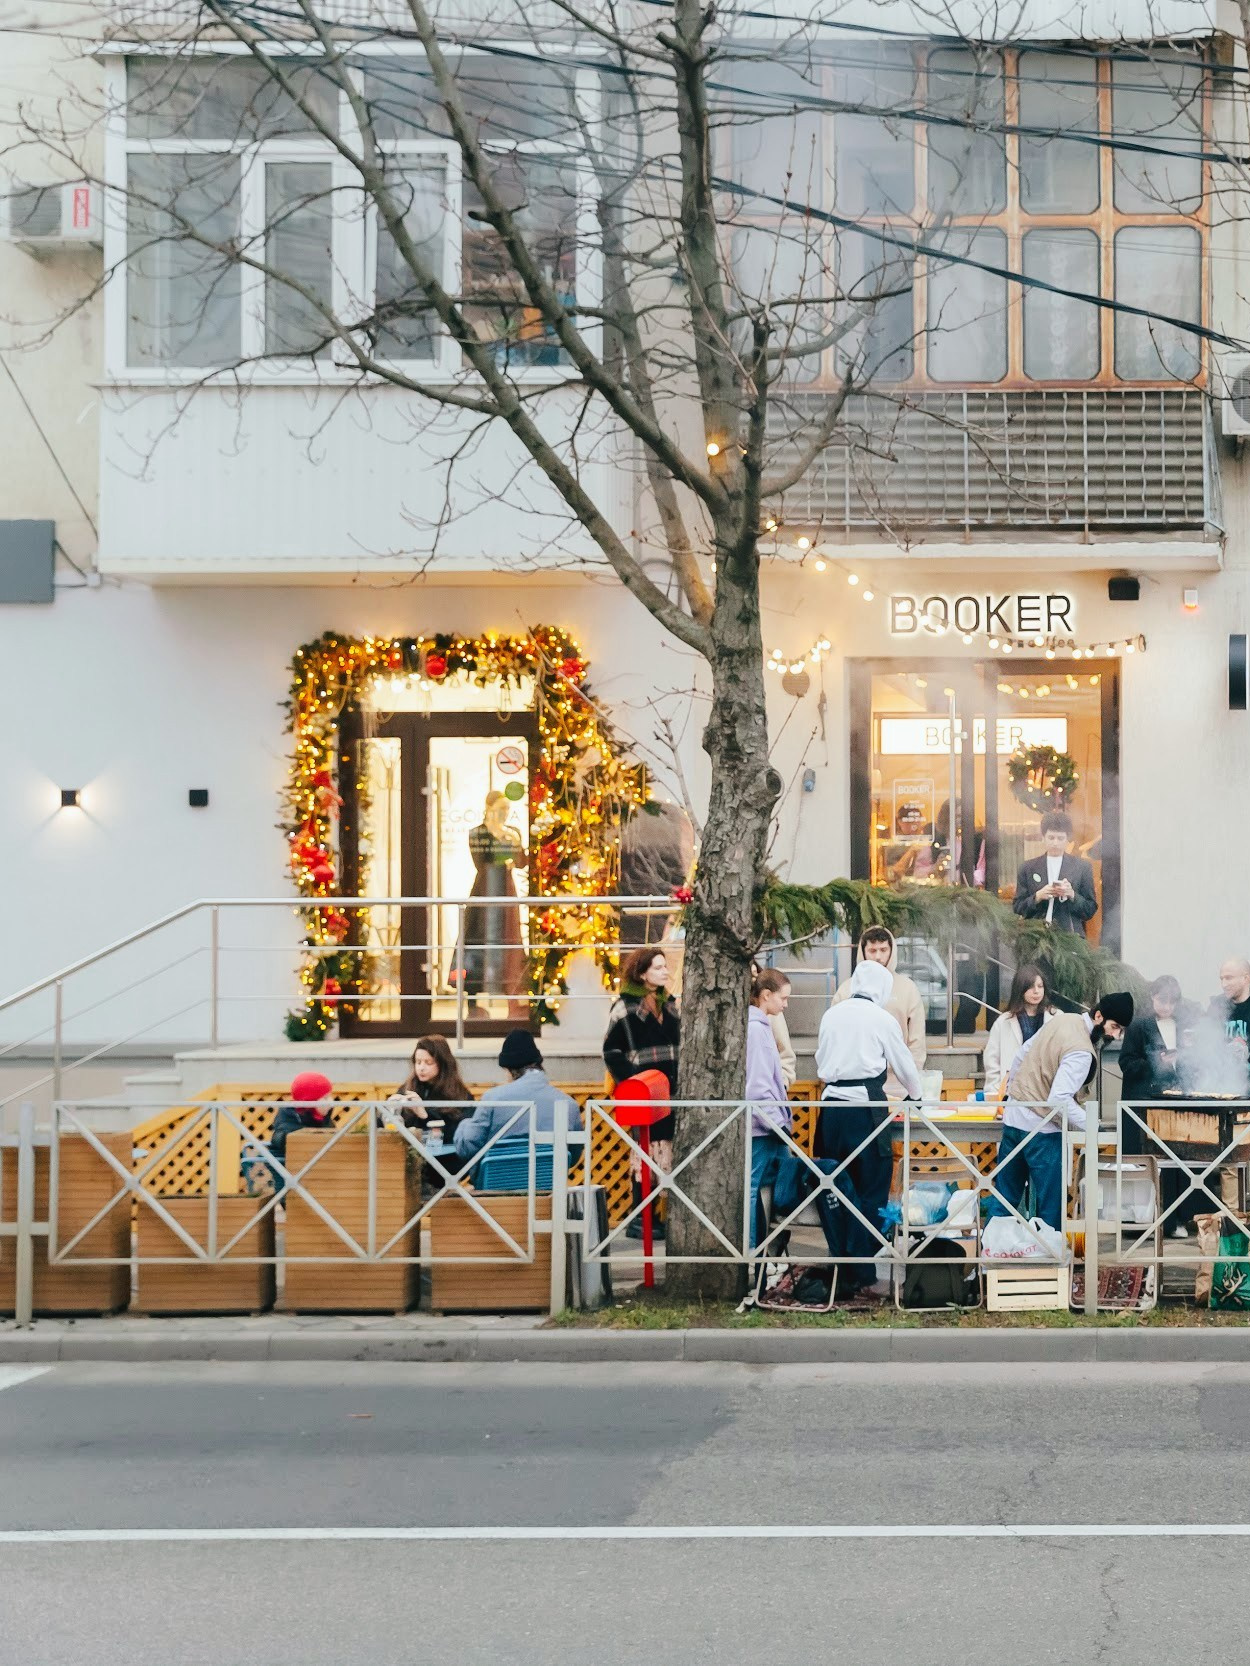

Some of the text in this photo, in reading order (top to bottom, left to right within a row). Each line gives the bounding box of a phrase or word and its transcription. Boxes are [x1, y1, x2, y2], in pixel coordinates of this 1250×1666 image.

[891, 595, 1073, 633] BOOKER
[1028, 635, 1075, 648] cffee
[925, 726, 1024, 746] BOKER
